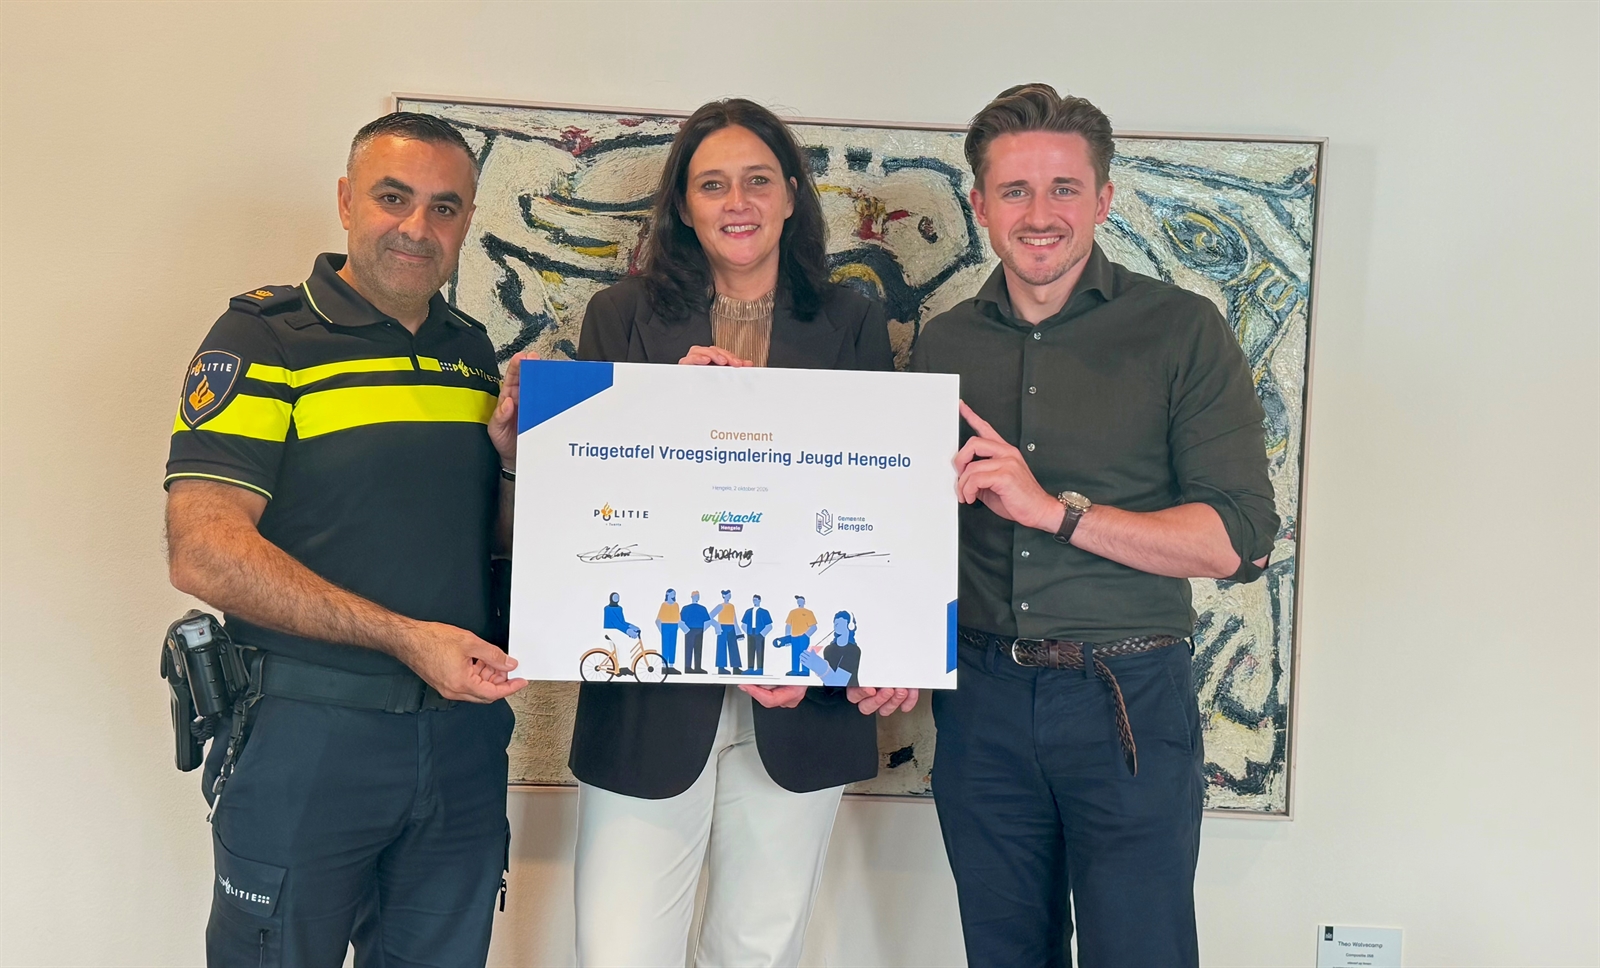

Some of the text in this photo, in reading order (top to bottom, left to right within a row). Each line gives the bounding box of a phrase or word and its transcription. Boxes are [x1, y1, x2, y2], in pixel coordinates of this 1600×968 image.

[710, 429, 774, 442] Convenant
[568, 442, 912, 470] Triagetafel Vroegsignalering Jeugd Hengelo
[593, 507, 649, 521] POLITIE
[701, 510, 763, 525] wijkracht
[837, 522, 874, 533] Hengelo
